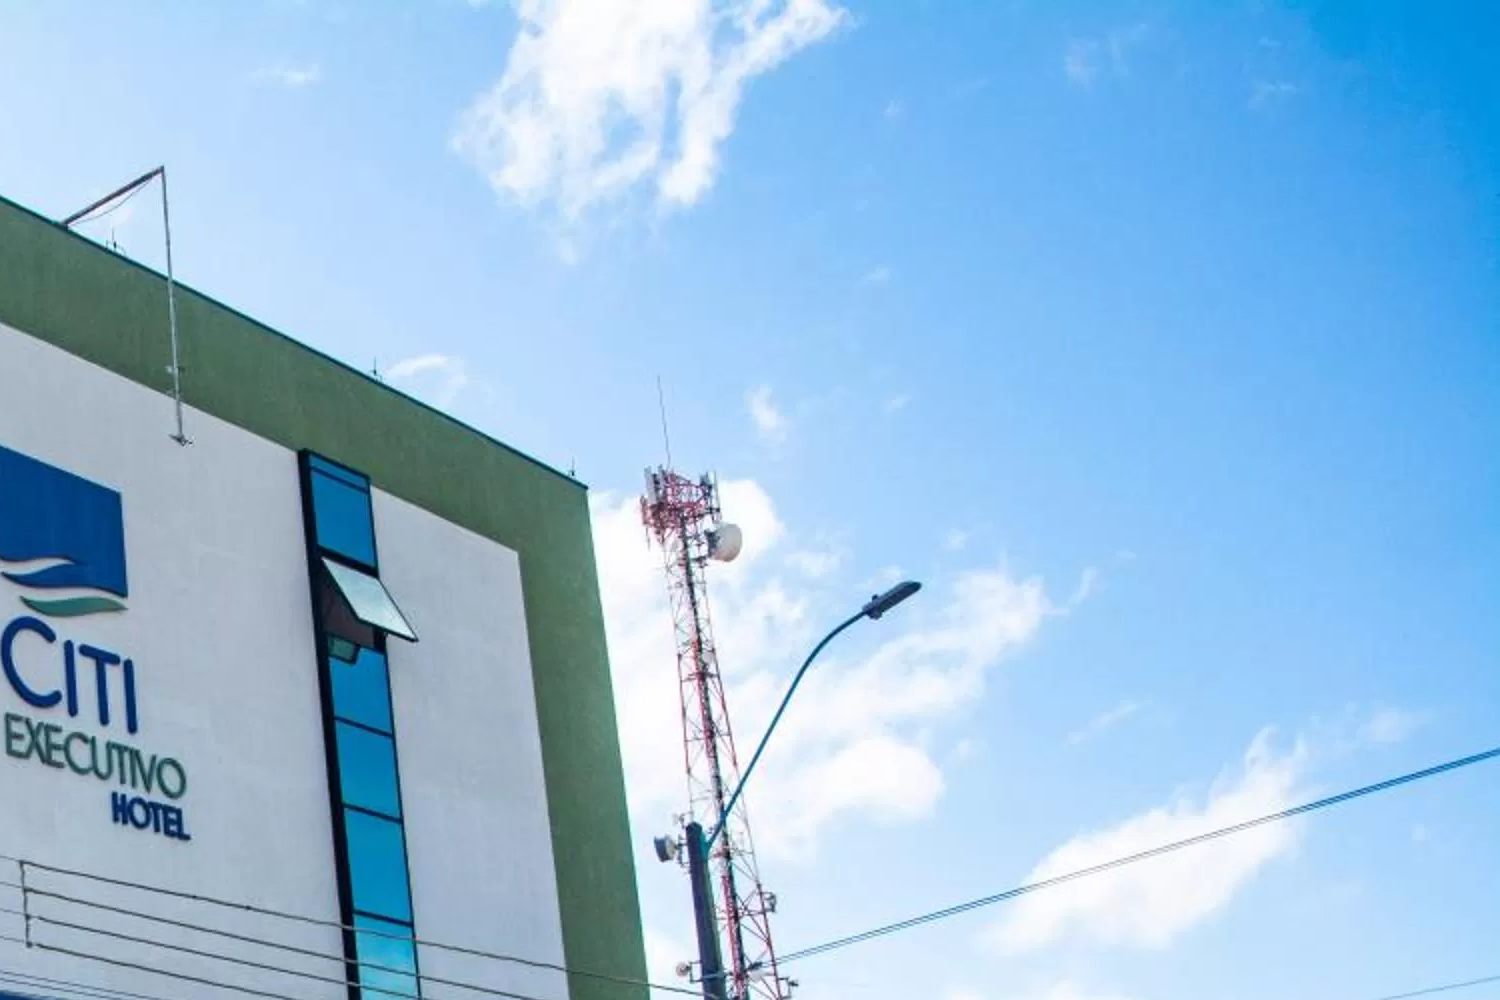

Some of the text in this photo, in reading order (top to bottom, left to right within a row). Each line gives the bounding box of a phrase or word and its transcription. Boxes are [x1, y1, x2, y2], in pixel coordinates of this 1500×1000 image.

[0, 615, 138, 735] CITI
[5, 713, 188, 798] EXECUTIVO
[111, 792, 192, 841] HOTEL
